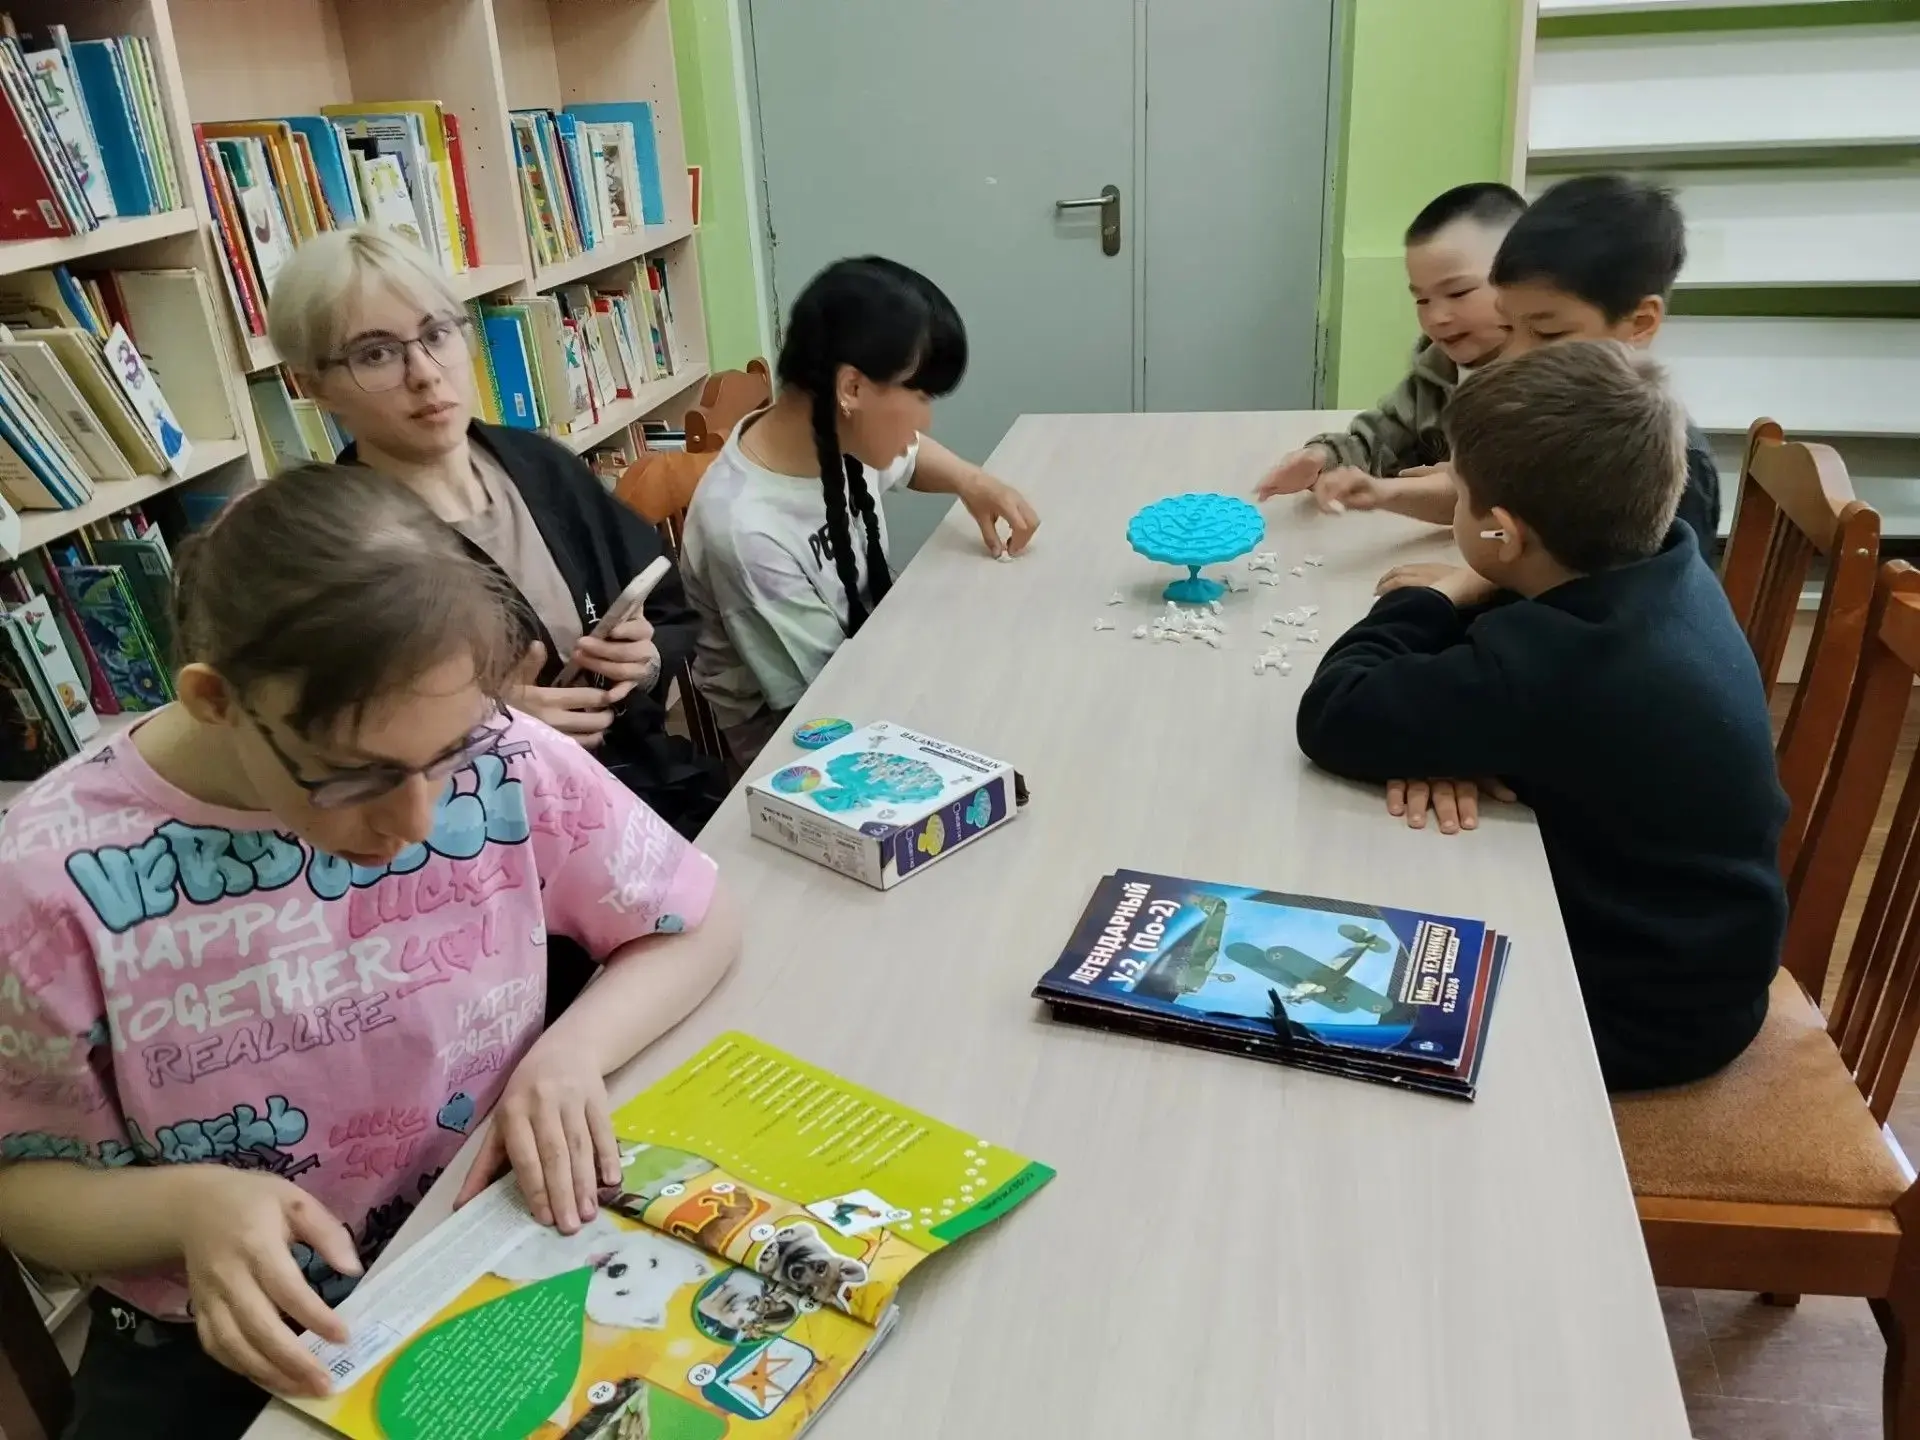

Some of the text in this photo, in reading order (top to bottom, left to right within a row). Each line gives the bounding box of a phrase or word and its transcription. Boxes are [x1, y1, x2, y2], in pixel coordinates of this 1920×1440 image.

[900, 731, 947, 750] BALANCE
[945, 746, 1002, 770] SPACEMAN
[94, 896, 332, 990] HAPPY
[1068, 881, 1152, 985] ЛЕГЕНДАРНЫЙ
[1107, 899, 1182, 985] У-2 (По-2)
[1415, 926, 1448, 1002] Мир ТЕХНИКИ
[107, 935, 410, 1053] TOGETHER
[1442, 977, 1460, 1013] 12.2024
[141, 1020, 289, 1088] REAL
[592, 1385, 610, 1400] 22
[694, 1367, 711, 1382] 20
